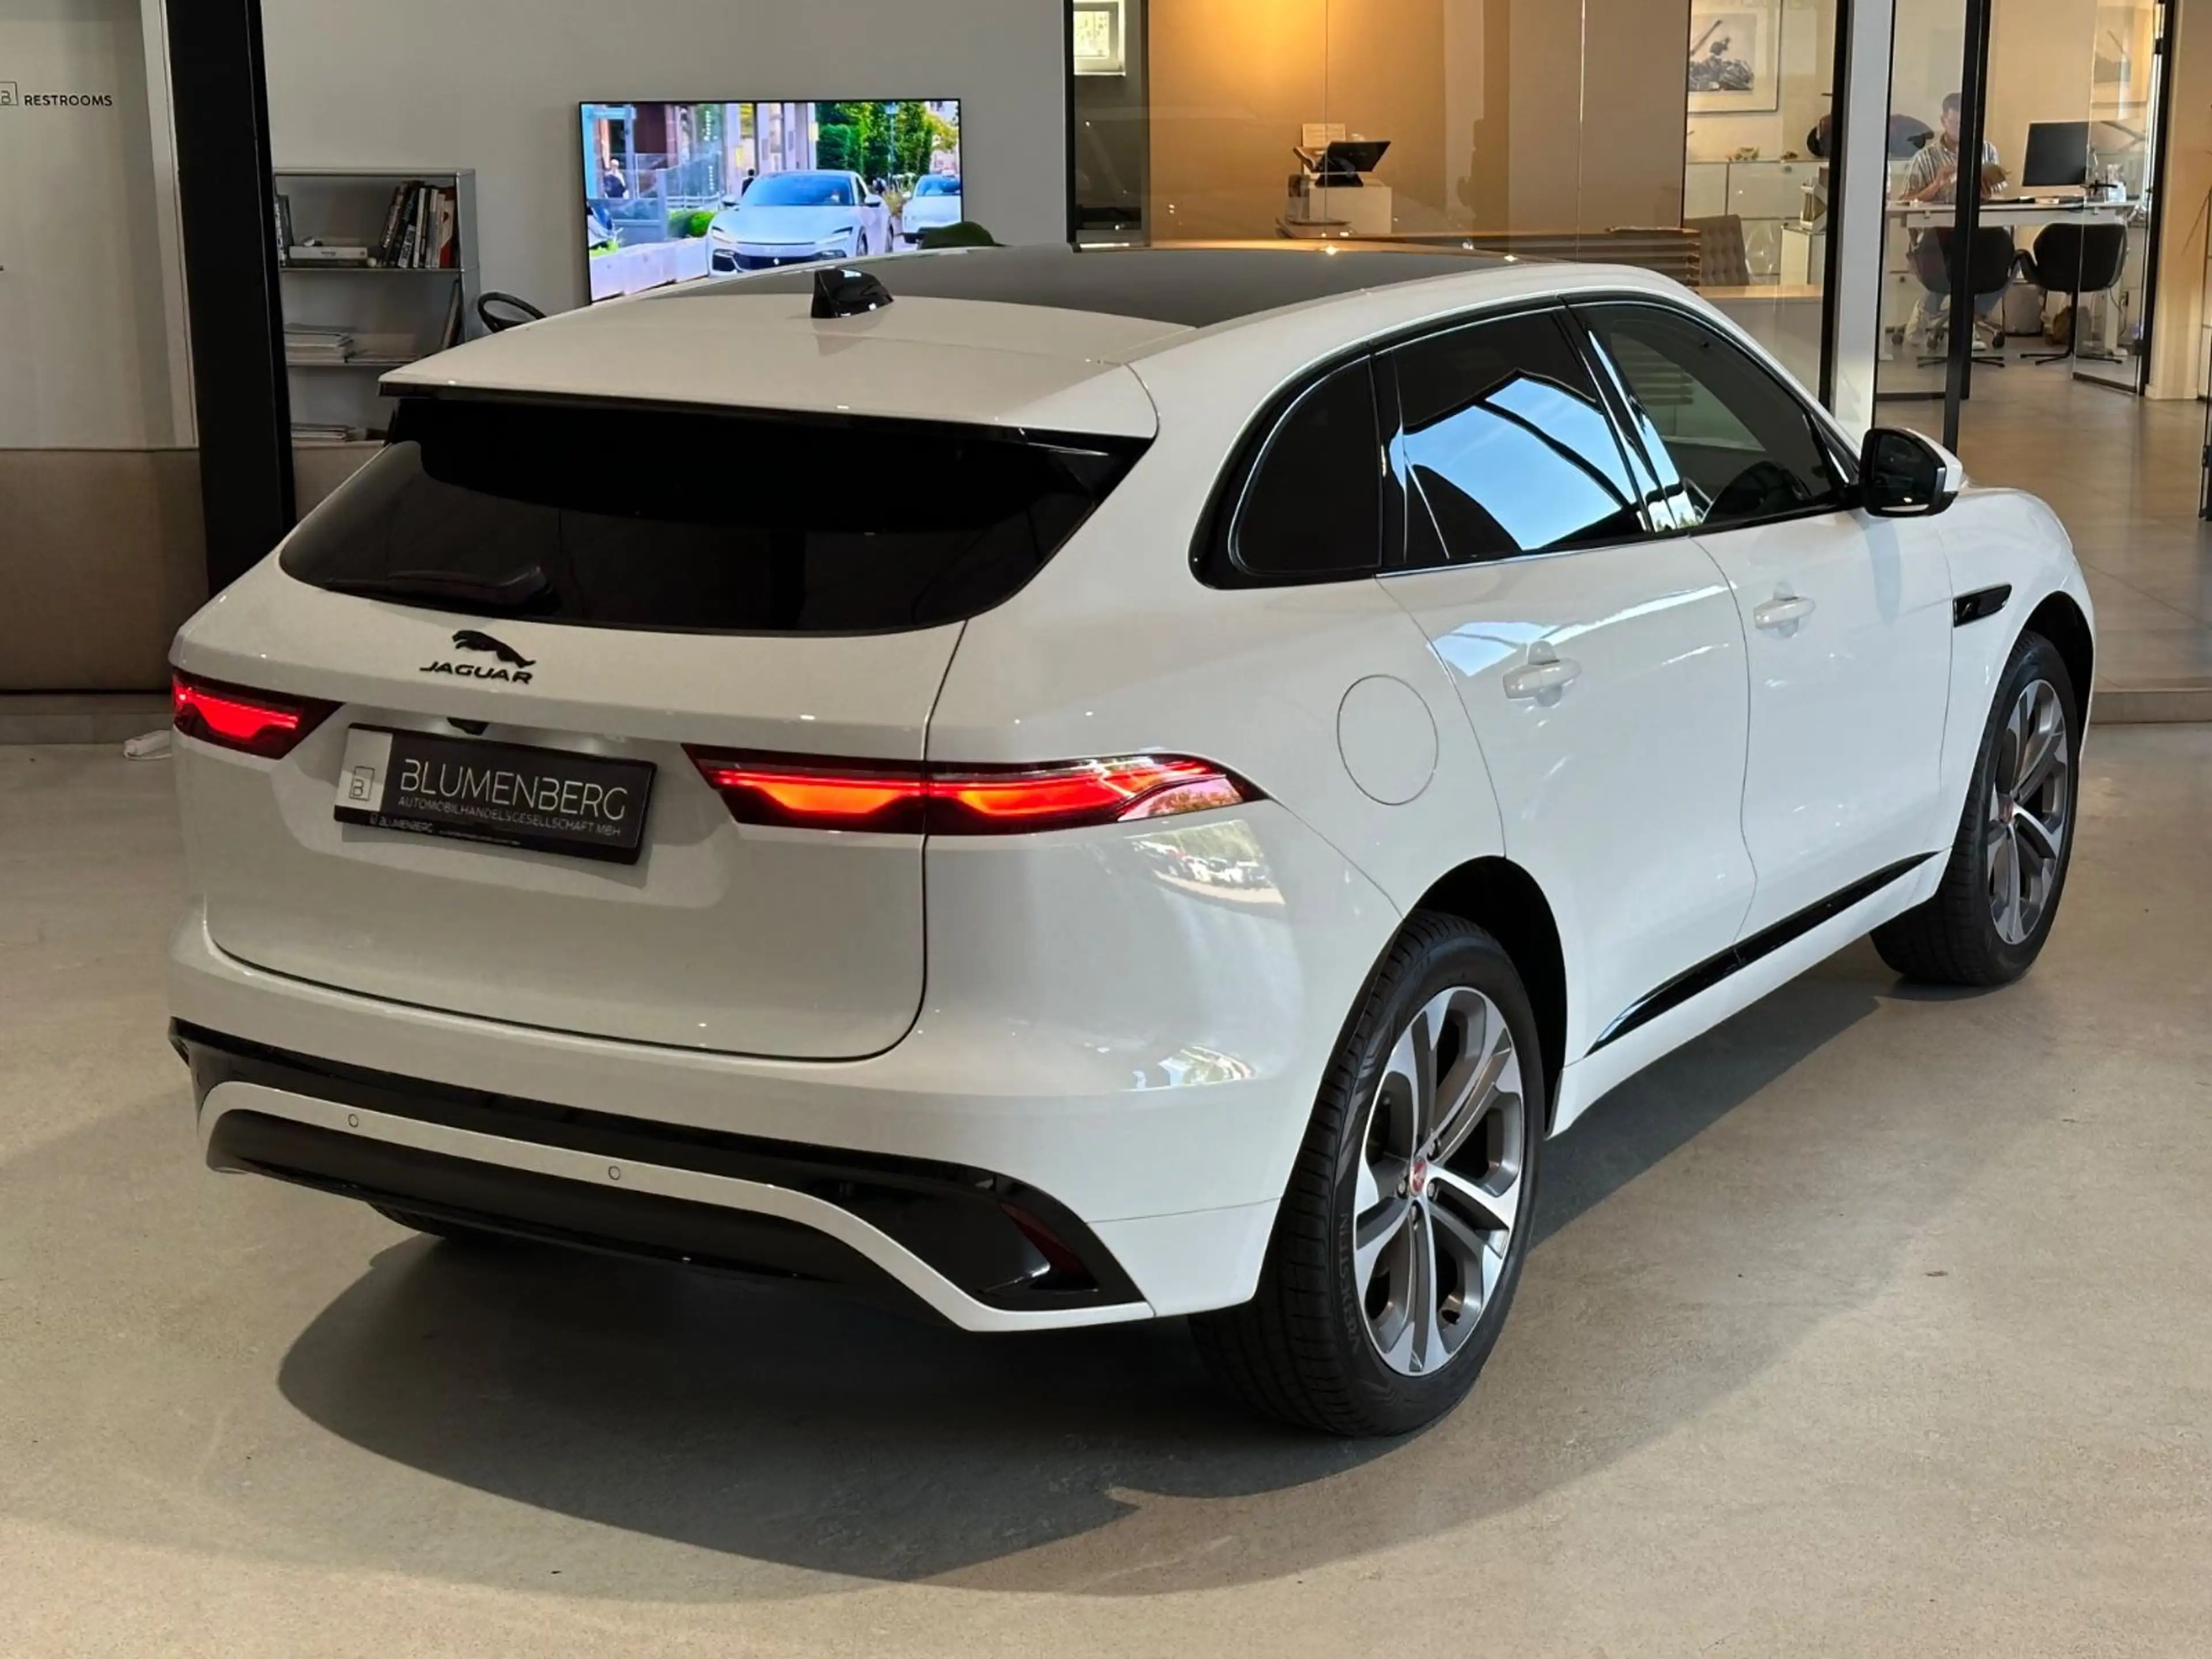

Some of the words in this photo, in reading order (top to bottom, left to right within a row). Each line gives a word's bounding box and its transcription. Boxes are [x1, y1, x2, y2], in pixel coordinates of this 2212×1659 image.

[24, 95, 112, 106] RESTROOMS
[419, 661, 533, 685] JAGUAR
[400, 758, 628, 821] BLUMENBERG
[398, 796, 594, 832] AUTOMOBILHANDELSGESELLSCHAFT
